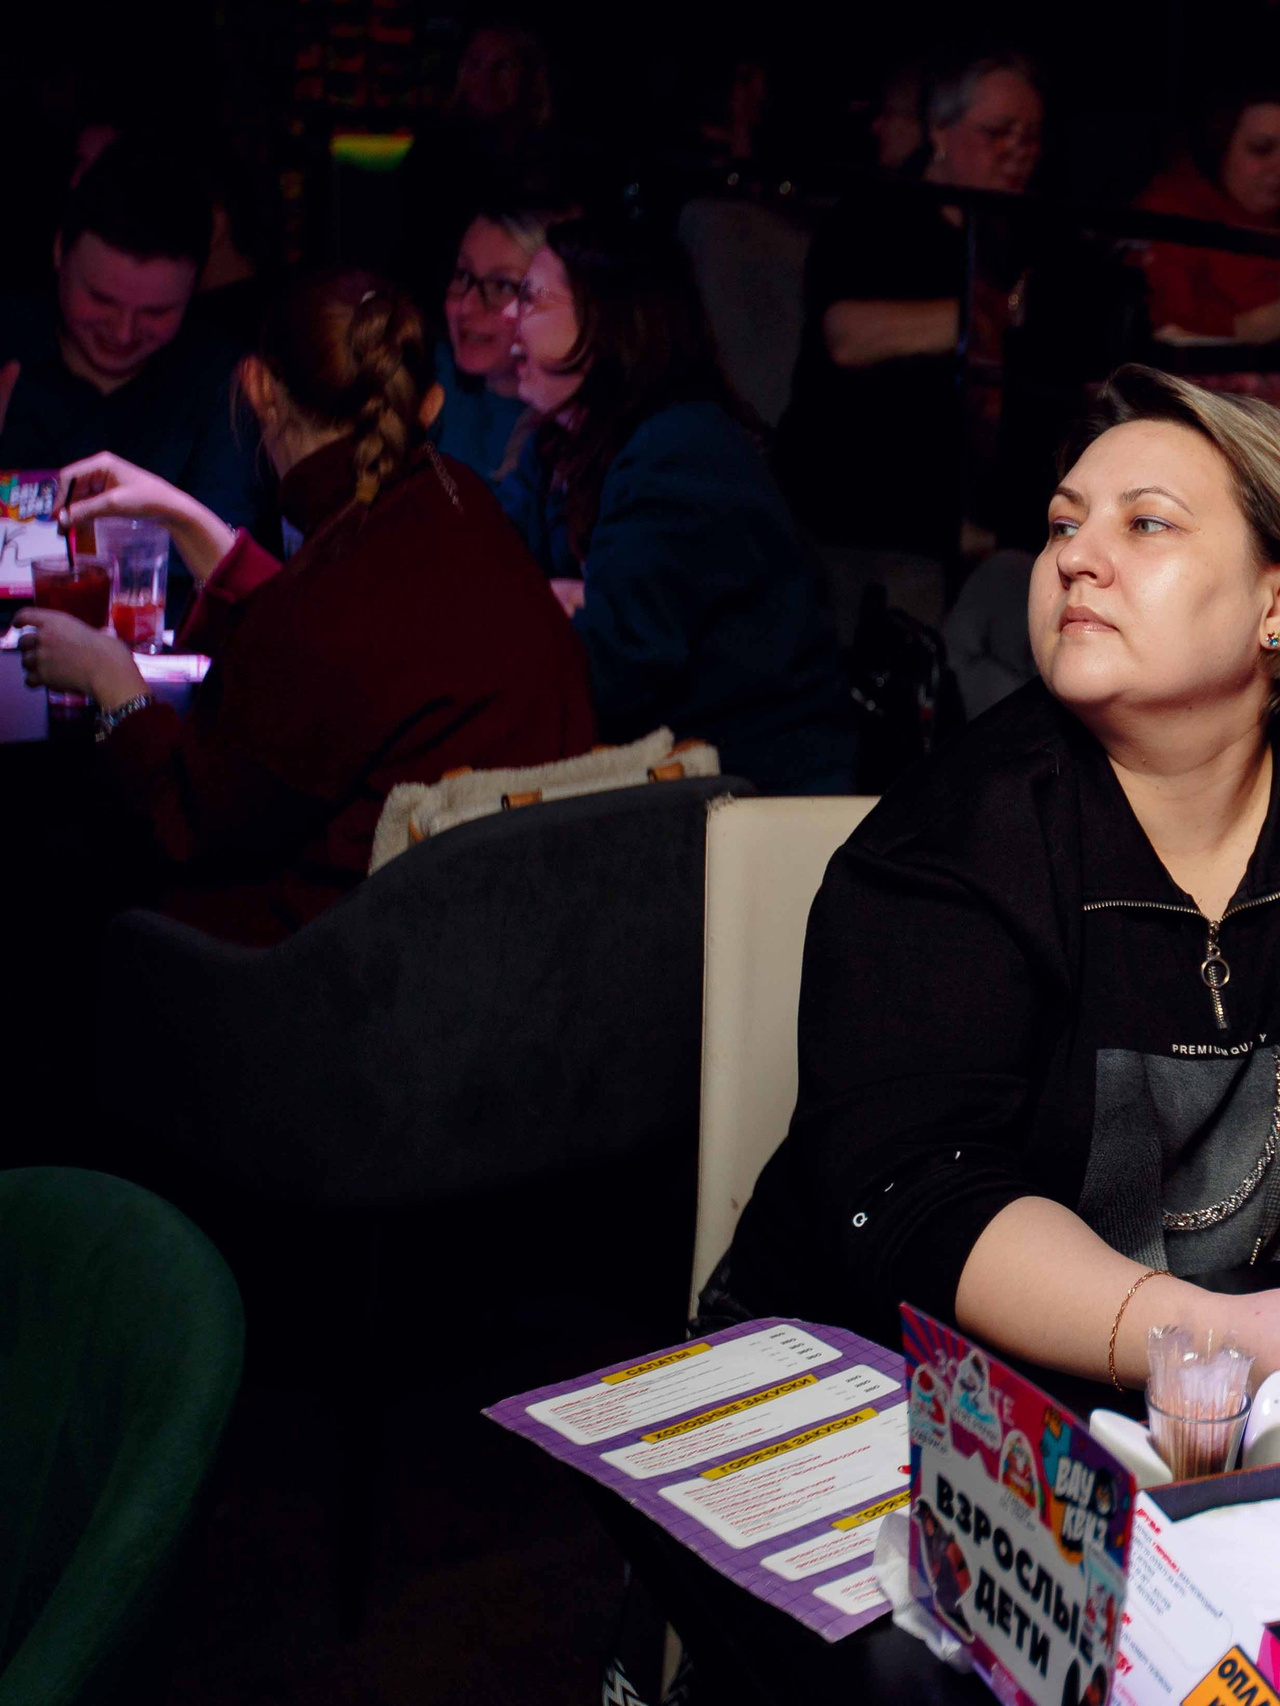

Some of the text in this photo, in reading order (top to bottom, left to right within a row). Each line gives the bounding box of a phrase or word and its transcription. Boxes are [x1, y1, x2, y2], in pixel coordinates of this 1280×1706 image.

[1172, 1043, 1228, 1056] PREMIUM
[625, 1351, 690, 1376] САЛАТЫ
[655, 1403, 742, 1440] ХОЛОДНЫЕ
[742, 1377, 813, 1407] ЗАКУСКИ
[720, 1441, 793, 1473] ГОРЯЧИЕ
[792, 1414, 864, 1446] ЗАКУСКИ
[1054, 1456, 1096, 1503] ВАУ
[974, 1566, 1050, 1678] ДЕТИ
